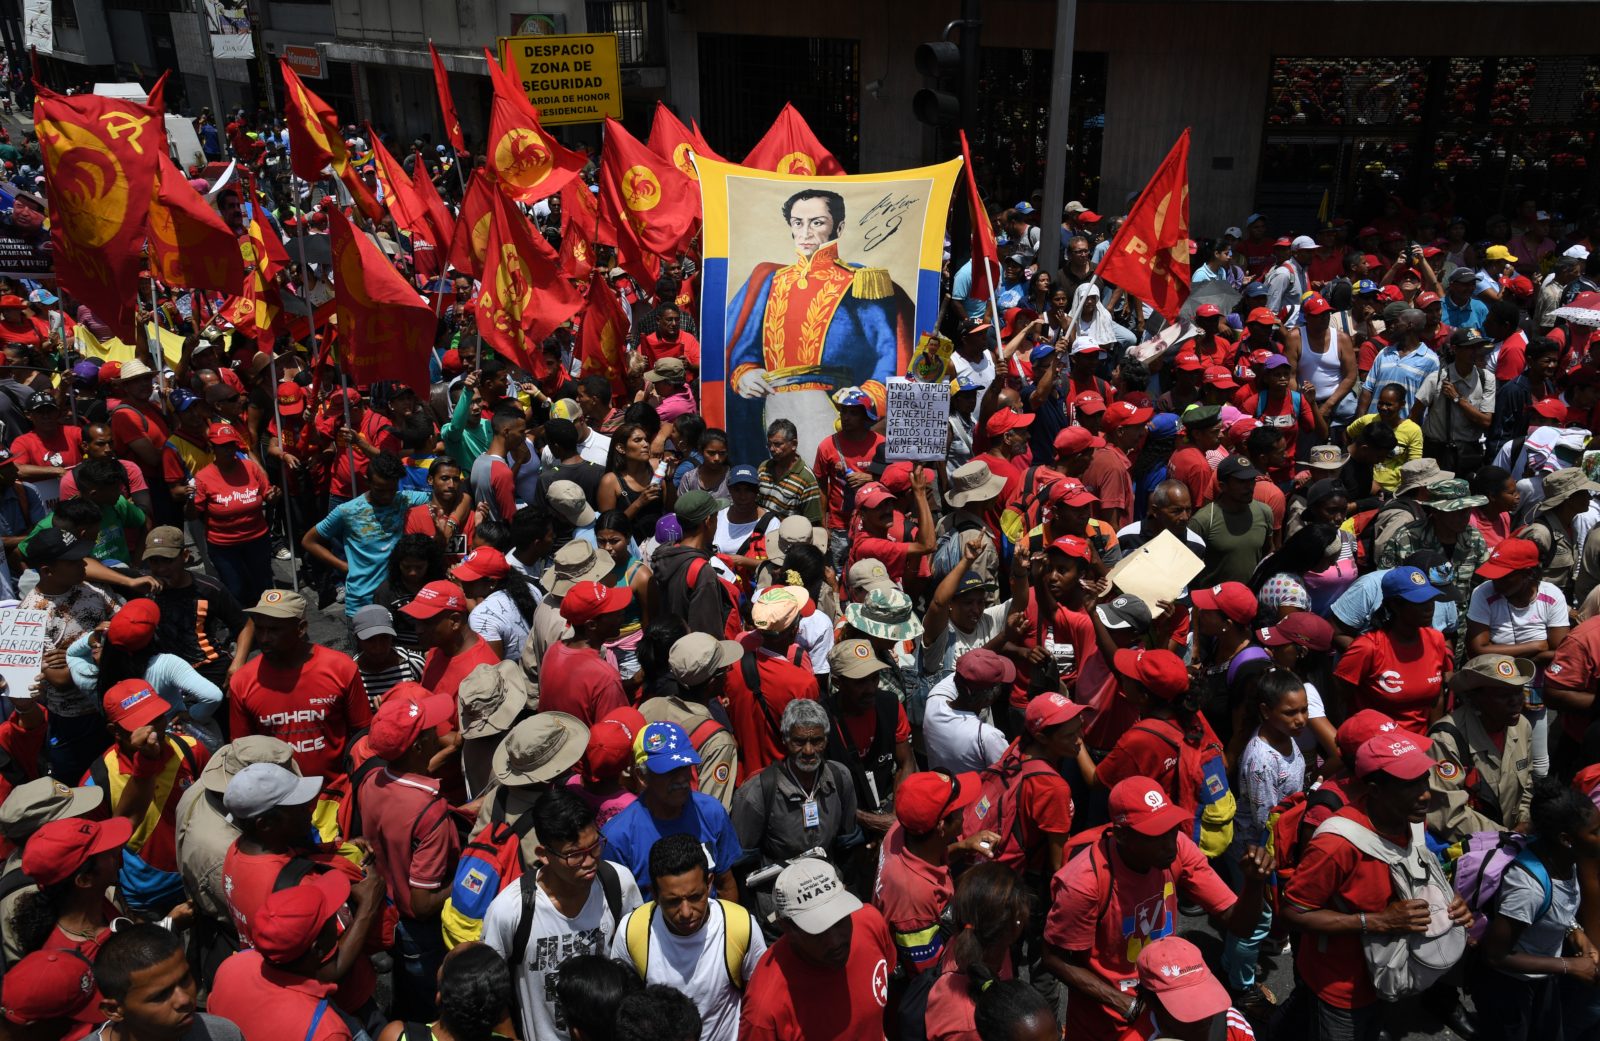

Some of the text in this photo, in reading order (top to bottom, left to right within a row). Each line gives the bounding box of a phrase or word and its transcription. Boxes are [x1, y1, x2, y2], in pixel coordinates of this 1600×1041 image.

[524, 44, 594, 57] DESPACIO
[531, 60, 592, 74] ZONA DE
[522, 76, 602, 91] SEGURIDAD
[526, 92, 611, 106] ARDIA DE HONOR
[538, 105, 598, 117] RESIDENCIAL
[889, 400, 933, 410] PORQUE
[890, 409, 944, 419] VENEZUELA
[888, 418, 899, 427] SE
[886, 437, 945, 446] VENEZUELA
[917, 445, 946, 455] RINDE
[216, 494, 232, 507] Hugo
[15, 611, 46, 622] FUCK
[0, 625, 39, 637] VETE
[258, 709, 325, 726] YOHAN
[796, 880, 837, 905] INASS
